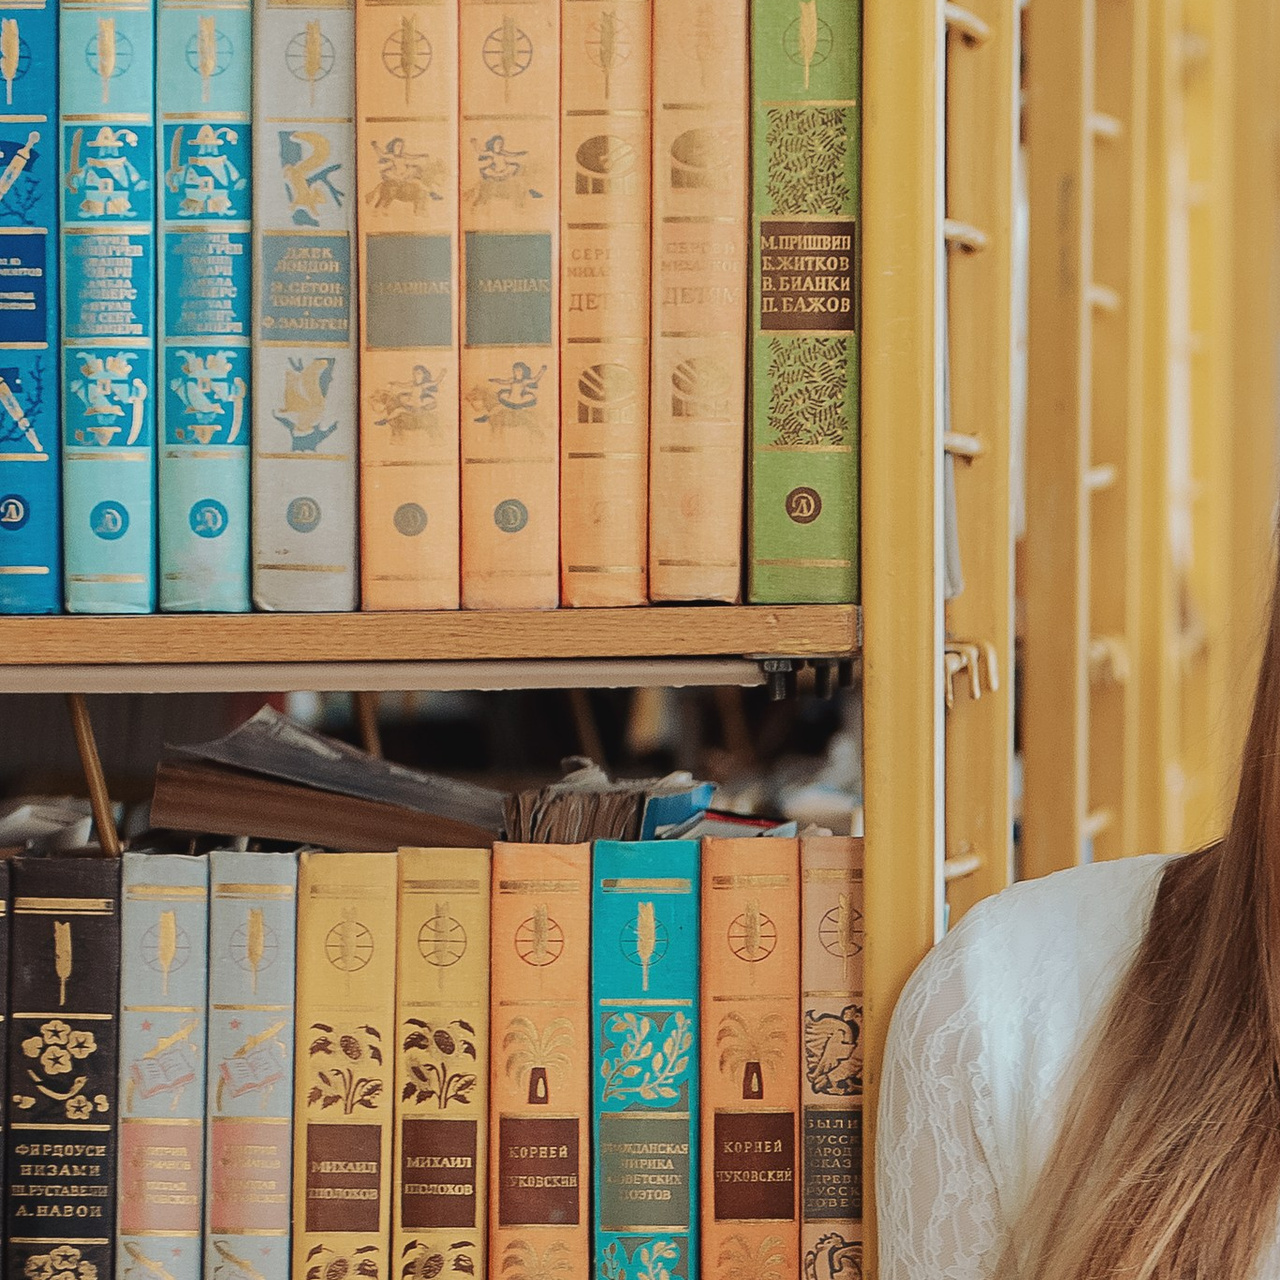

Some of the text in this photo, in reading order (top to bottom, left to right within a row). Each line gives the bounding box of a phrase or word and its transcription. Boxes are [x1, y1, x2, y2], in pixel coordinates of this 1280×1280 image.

[15, 1144, 107, 1157] ФИРДОУСИ
[508, 1145, 569, 1158] КОРНЕЙ
[723, 1140, 783, 1154] КОРНЕЙ
[311, 1161, 377, 1174] МИХАИЛ
[406, 1156, 472, 1169] МИХАИЛ
[20, 1164, 101, 1177] НИЗАМИ
[716, 1168, 792, 1182] ЧУКОВСКИЙ
[506, 1172, 578, 1188] УКОВСКИЙ
[608, 1174, 682, 1185] ОВЕТСКИХ
